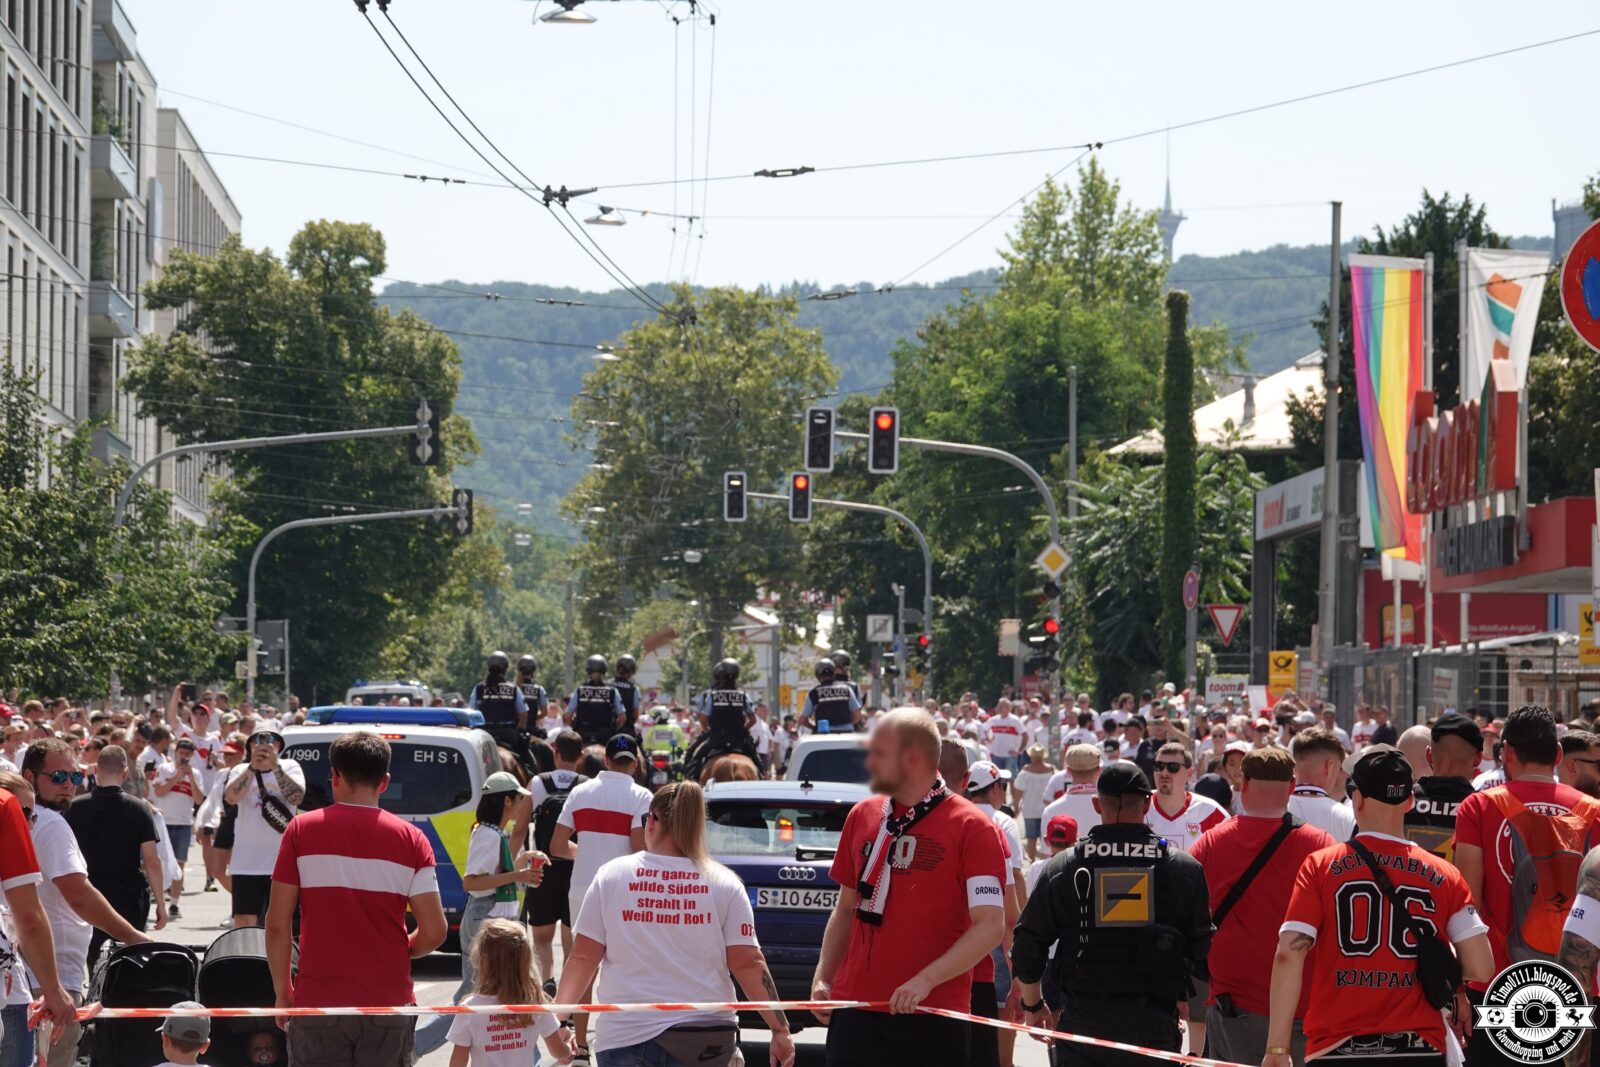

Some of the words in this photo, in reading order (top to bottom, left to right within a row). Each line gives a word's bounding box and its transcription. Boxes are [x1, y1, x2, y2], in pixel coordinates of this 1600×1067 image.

[580, 689, 610, 698] POLIZEI
[713, 692, 744, 702] POLIZEI
[818, 688, 849, 697] POLIZEI
[413, 750, 434, 763] EH
[437, 751, 448, 763] S
[452, 752, 459, 764] 1
[1412, 800, 1459, 816] OLIZ
[1084, 842, 1162, 858] POLIZEI
[636, 868, 659, 877] Der
[662, 870, 700, 881] ganze
[1330, 852, 1445, 886] SCHWABEN
[629, 881, 664, 893] wilde
[667, 883, 709, 895] Süden
[975, 886, 1000, 896] ORDNER
[637, 898, 680, 910] strahlt
[683, 899, 696, 910] in
[759, 890, 768, 905] S
[622, 910, 653, 922] Weiß
[656, 913, 680, 924] und
[684, 913, 704, 924] Rot
[1336, 970, 1418, 988] KOMPAN
